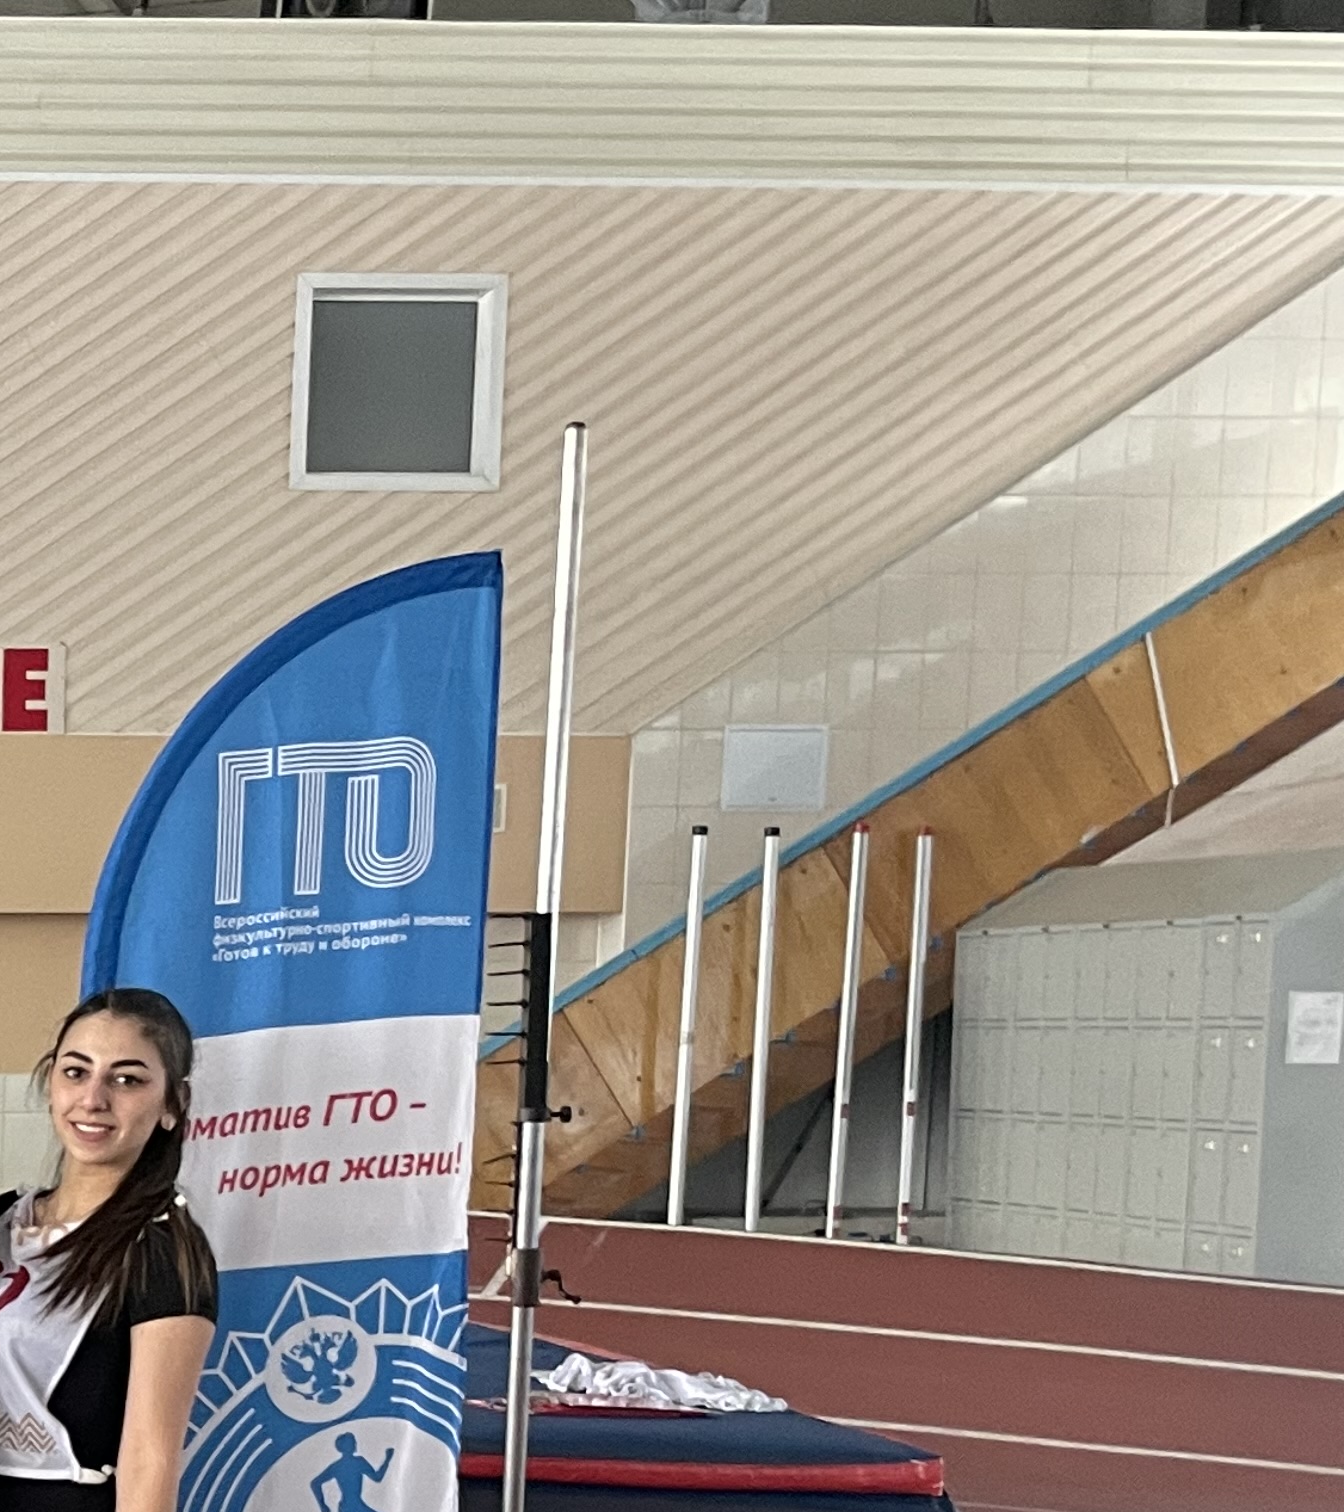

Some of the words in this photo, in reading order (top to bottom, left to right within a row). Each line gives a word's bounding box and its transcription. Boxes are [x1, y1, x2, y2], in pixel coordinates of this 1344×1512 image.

[215, 736, 437, 905] ГТО
[213, 913, 410, 948] физкультурно-спортивный
[214, 906, 320, 930] Всероссийский
[323, 1088, 398, 1126] ГТО
[218, 1158, 330, 1197] норма
[339, 1142, 462, 1183] жизни!
